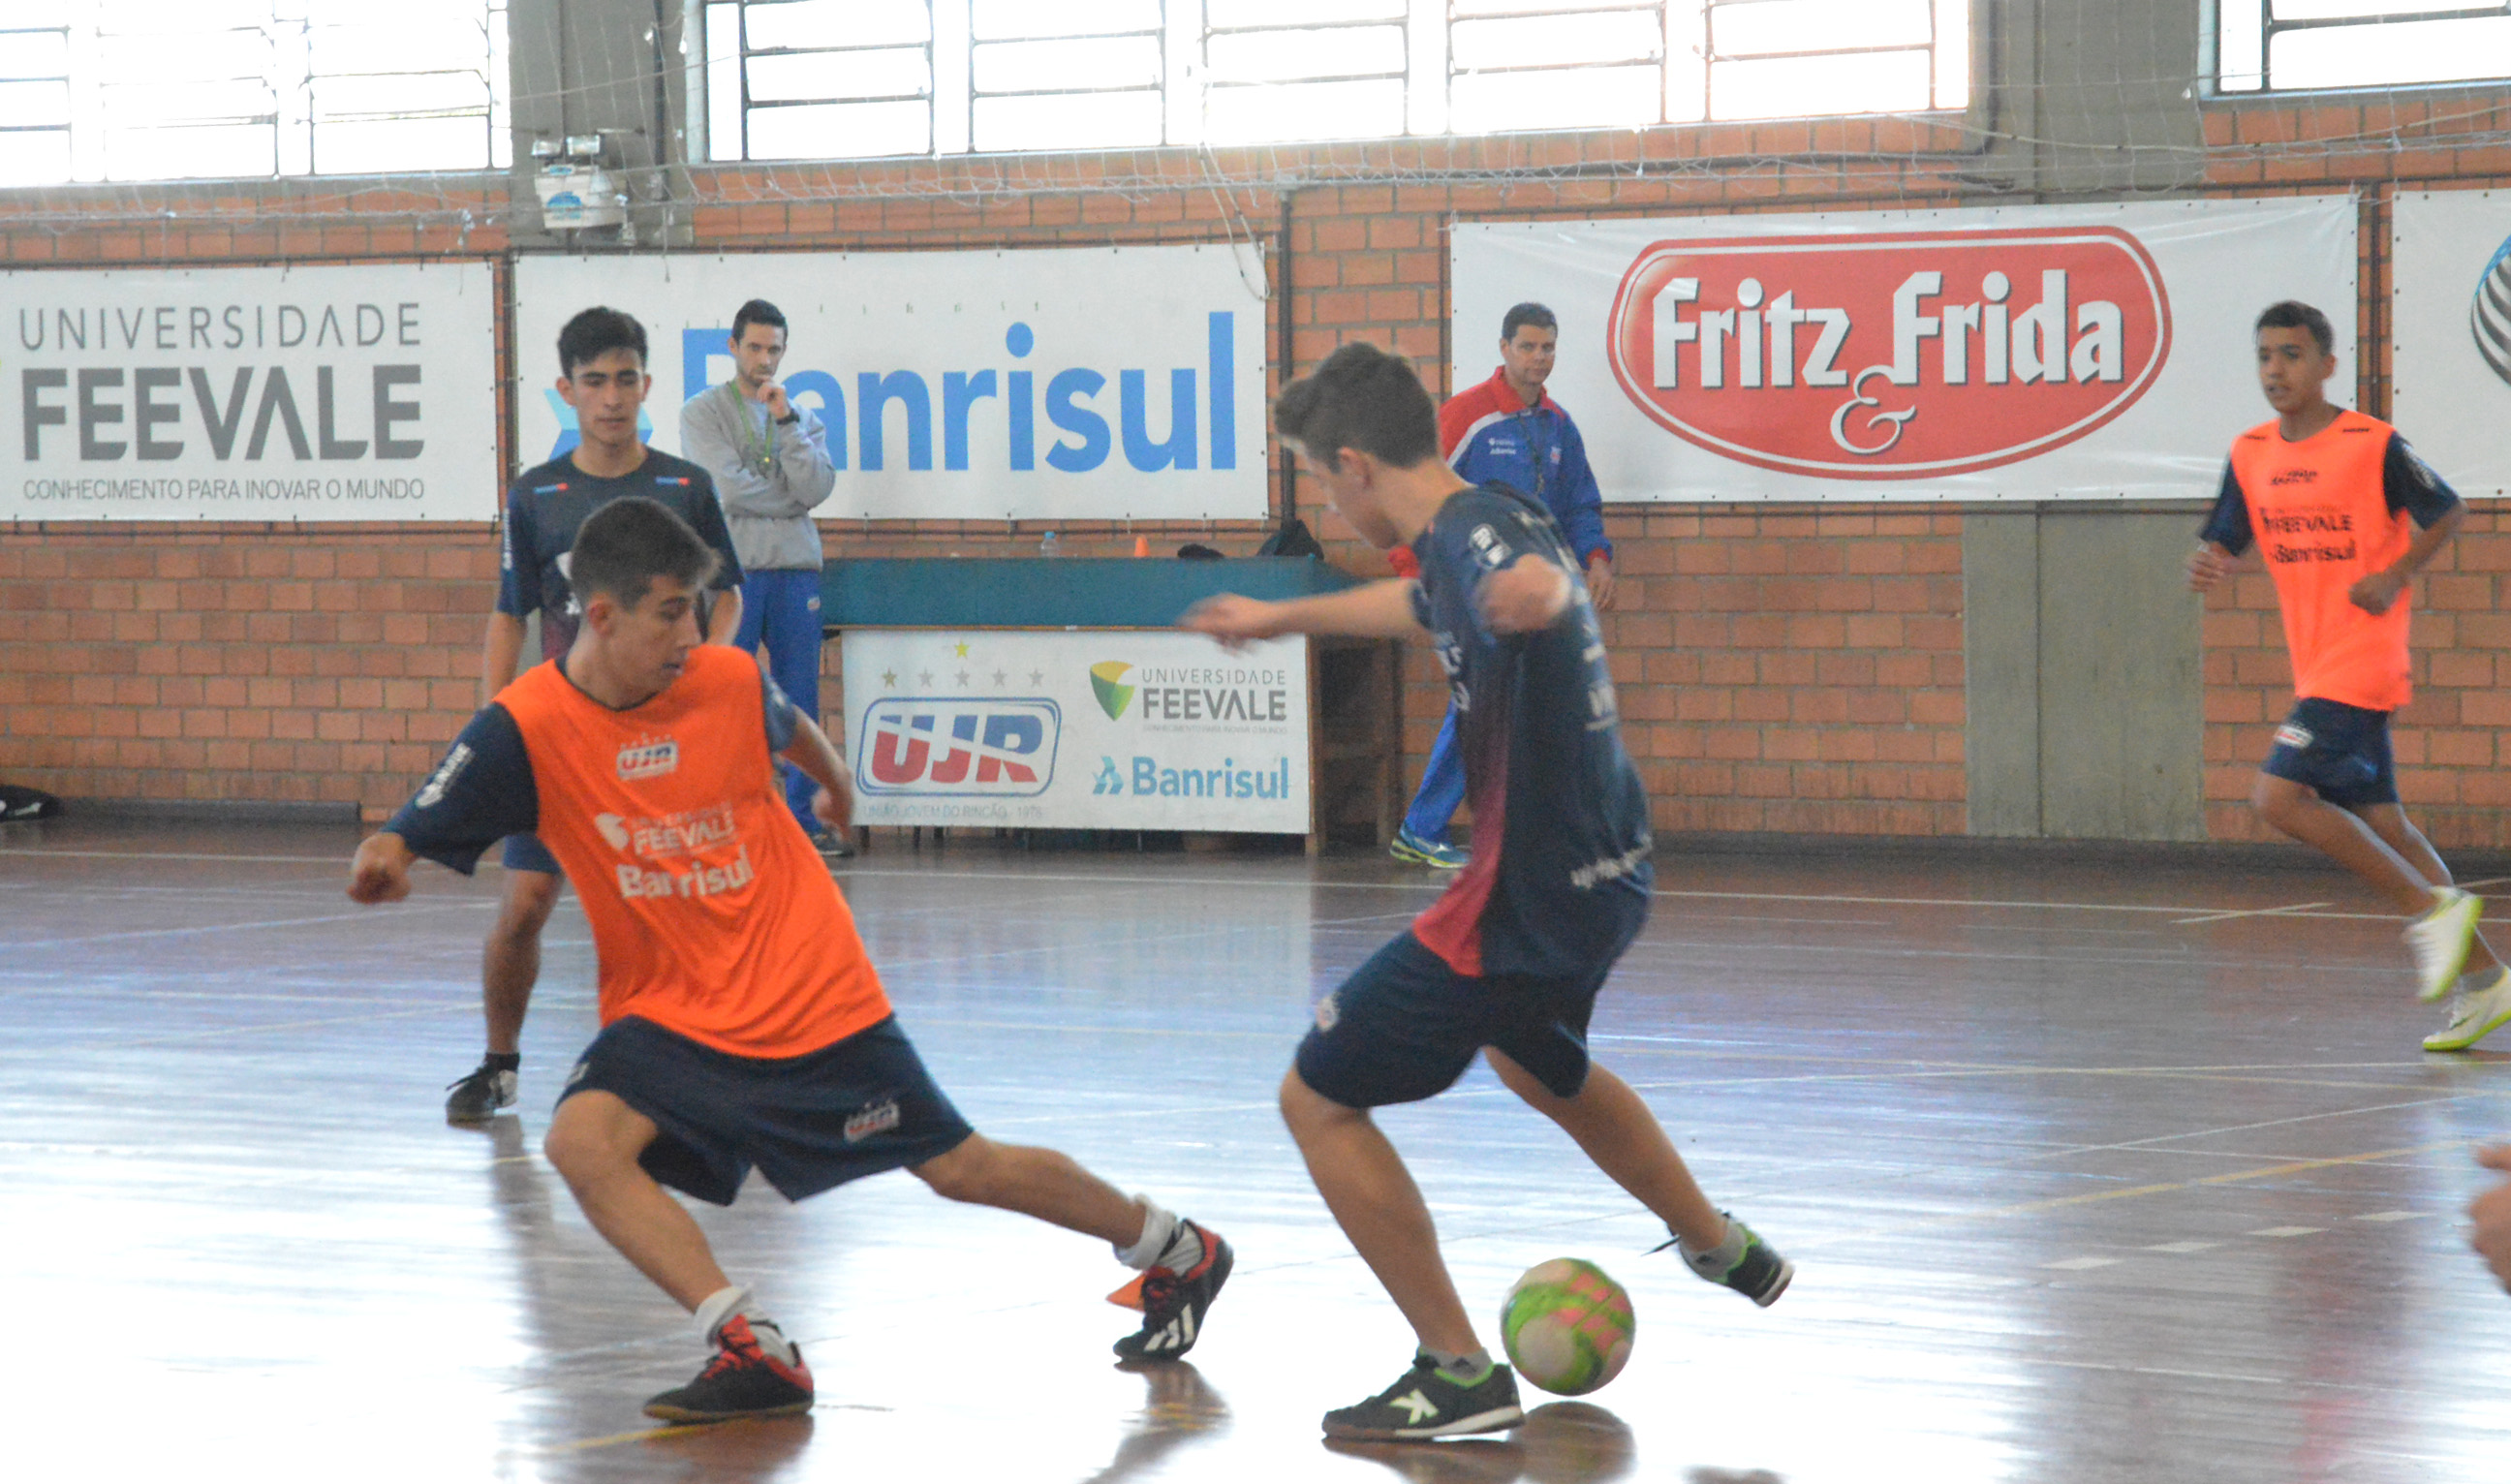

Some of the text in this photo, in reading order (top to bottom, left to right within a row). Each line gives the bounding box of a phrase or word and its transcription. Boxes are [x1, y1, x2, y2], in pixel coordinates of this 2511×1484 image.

[19, 303, 421, 351] UNIVERSIDADE
[1652, 268, 2124, 389] Fritz Frida
[21, 364, 425, 462] FEEVALE
[23, 479, 425, 501] CONHECIMENTO PARA INOVAR O MUNDO
[1141, 668, 1286, 685] UNIVERSIDADE
[1142, 688, 1287, 721] FEEVALE
[871, 714, 1044, 784] UJR
[1132, 756, 1288, 800] Banrisul
